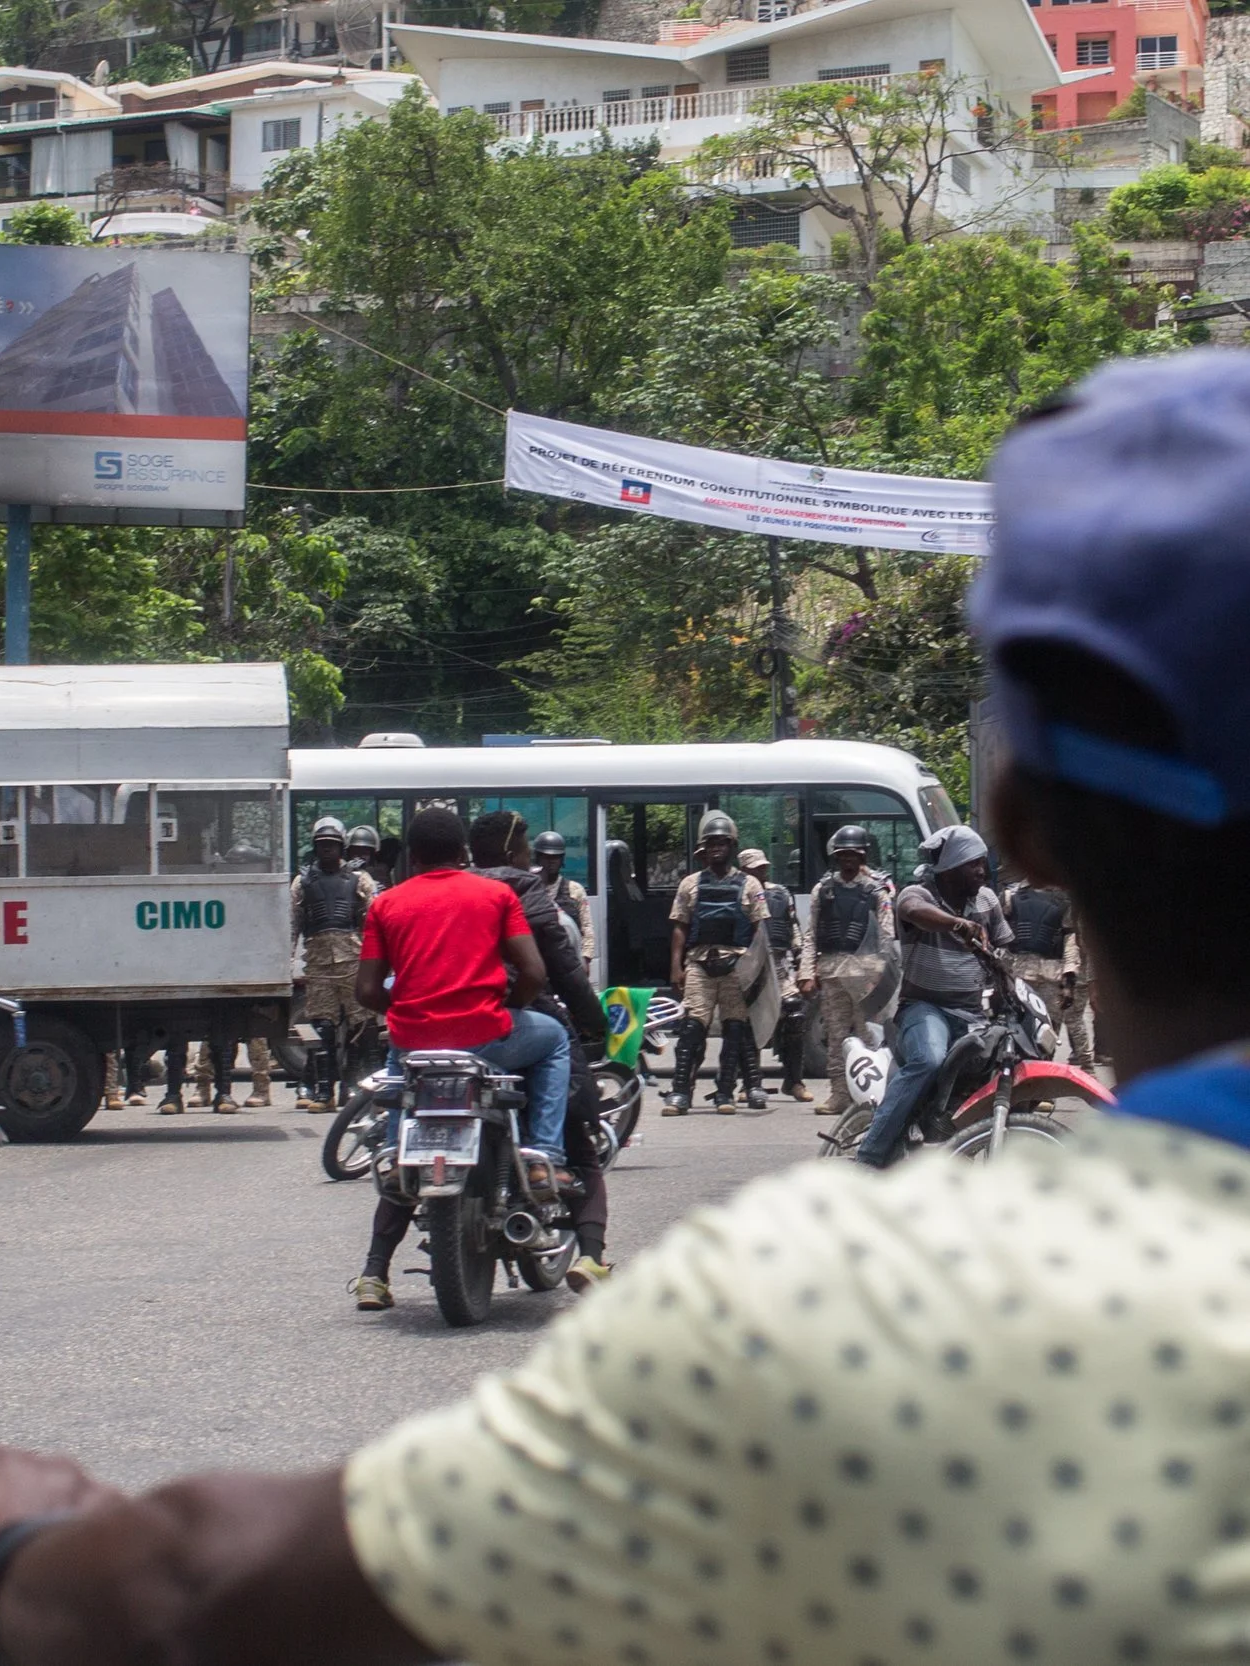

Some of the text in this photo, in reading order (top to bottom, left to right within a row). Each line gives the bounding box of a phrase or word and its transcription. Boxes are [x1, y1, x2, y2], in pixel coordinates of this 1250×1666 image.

[127, 454, 174, 468] SOGE
[127, 468, 227, 484] ASSURANCE
[529, 445, 577, 463] PROJET
[581, 457, 598, 469] DE
[700, 481, 820, 507] CONSTITUTIONNEL
[823, 499, 909, 517] SYMBOLIQUE
[912, 508, 946, 520] AVEC
[950, 511, 973, 520] LES
[747, 514, 760, 522] LES
[762, 516, 790, 525] JEUNES
[792, 519, 802, 527] SE
[773, 508, 829, 520] CHANGEMENT
[852, 517, 907, 528] CONSTITUTION
[135, 900, 226, 931] CIMO
